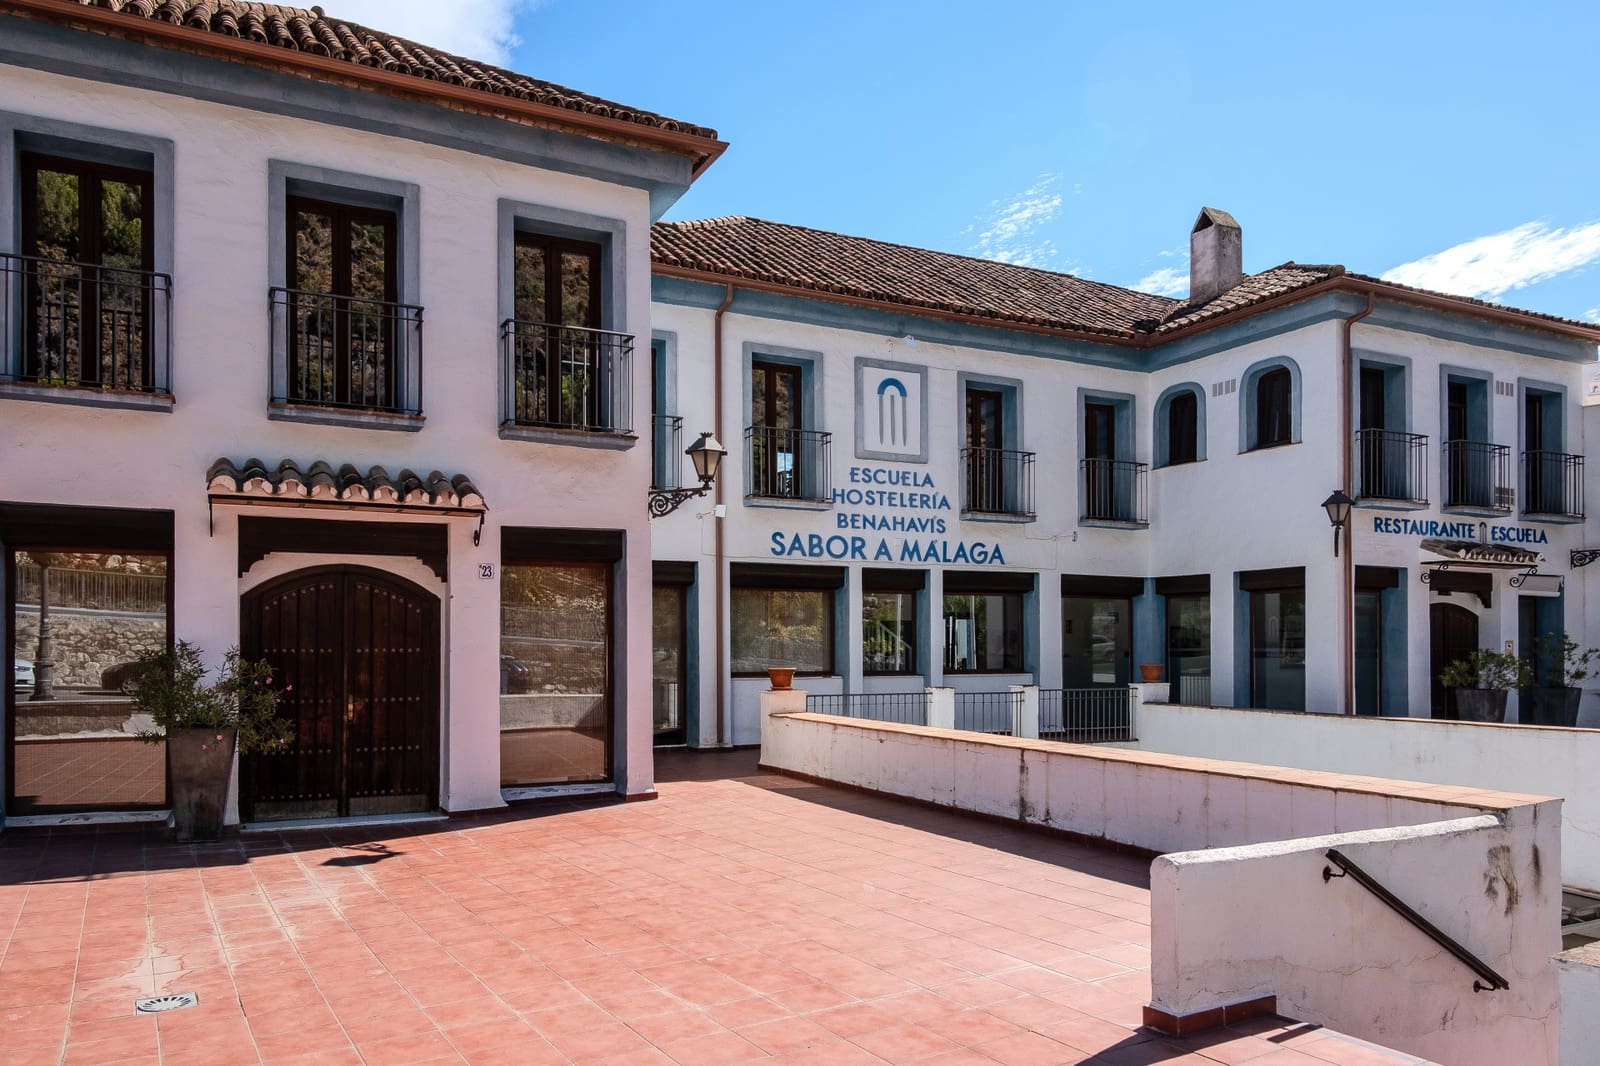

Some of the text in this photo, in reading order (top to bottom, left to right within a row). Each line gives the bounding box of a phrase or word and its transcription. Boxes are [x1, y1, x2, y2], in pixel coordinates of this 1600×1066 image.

[850, 466, 935, 488] ESCUELA
[832, 488, 951, 510] HOSTELERÍA
[837, 512, 946, 534] BENAHAVÍS
[1373, 516, 1548, 544] RESTAURANTE ESCUELA
[771, 532, 1005, 565] SABOR A MÁLAGA
[481, 565, 492, 577] 23
